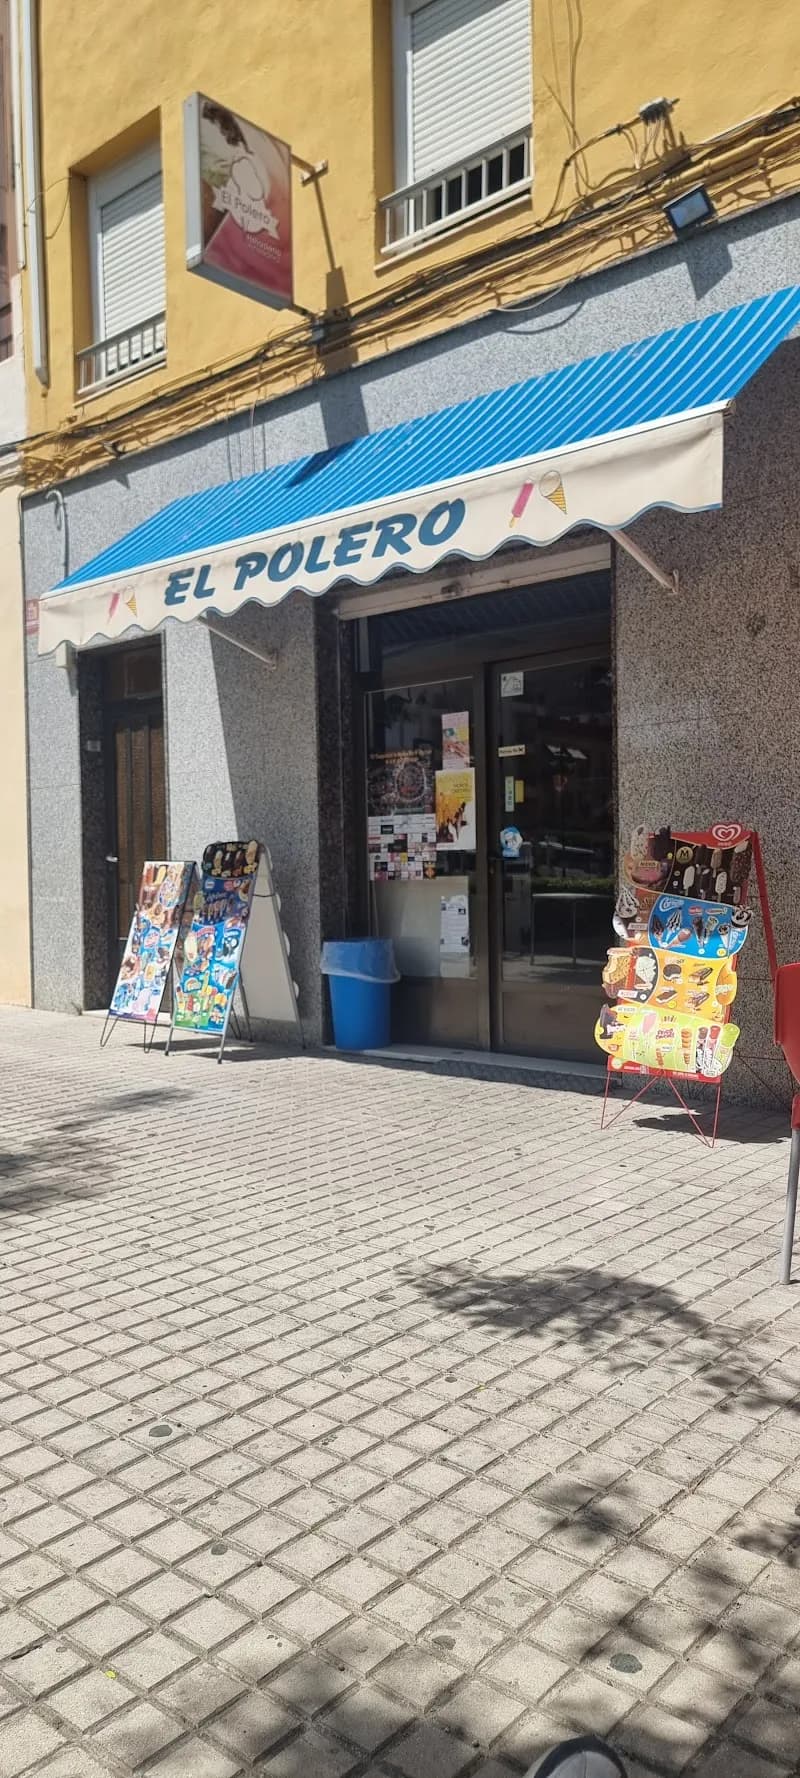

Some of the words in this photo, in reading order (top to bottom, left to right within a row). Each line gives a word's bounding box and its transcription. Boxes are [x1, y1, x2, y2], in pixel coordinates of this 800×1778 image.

[234, 197, 271, 225] Polero
[164, 564, 215, 606] EL
[233, 498, 466, 590] POLERO
